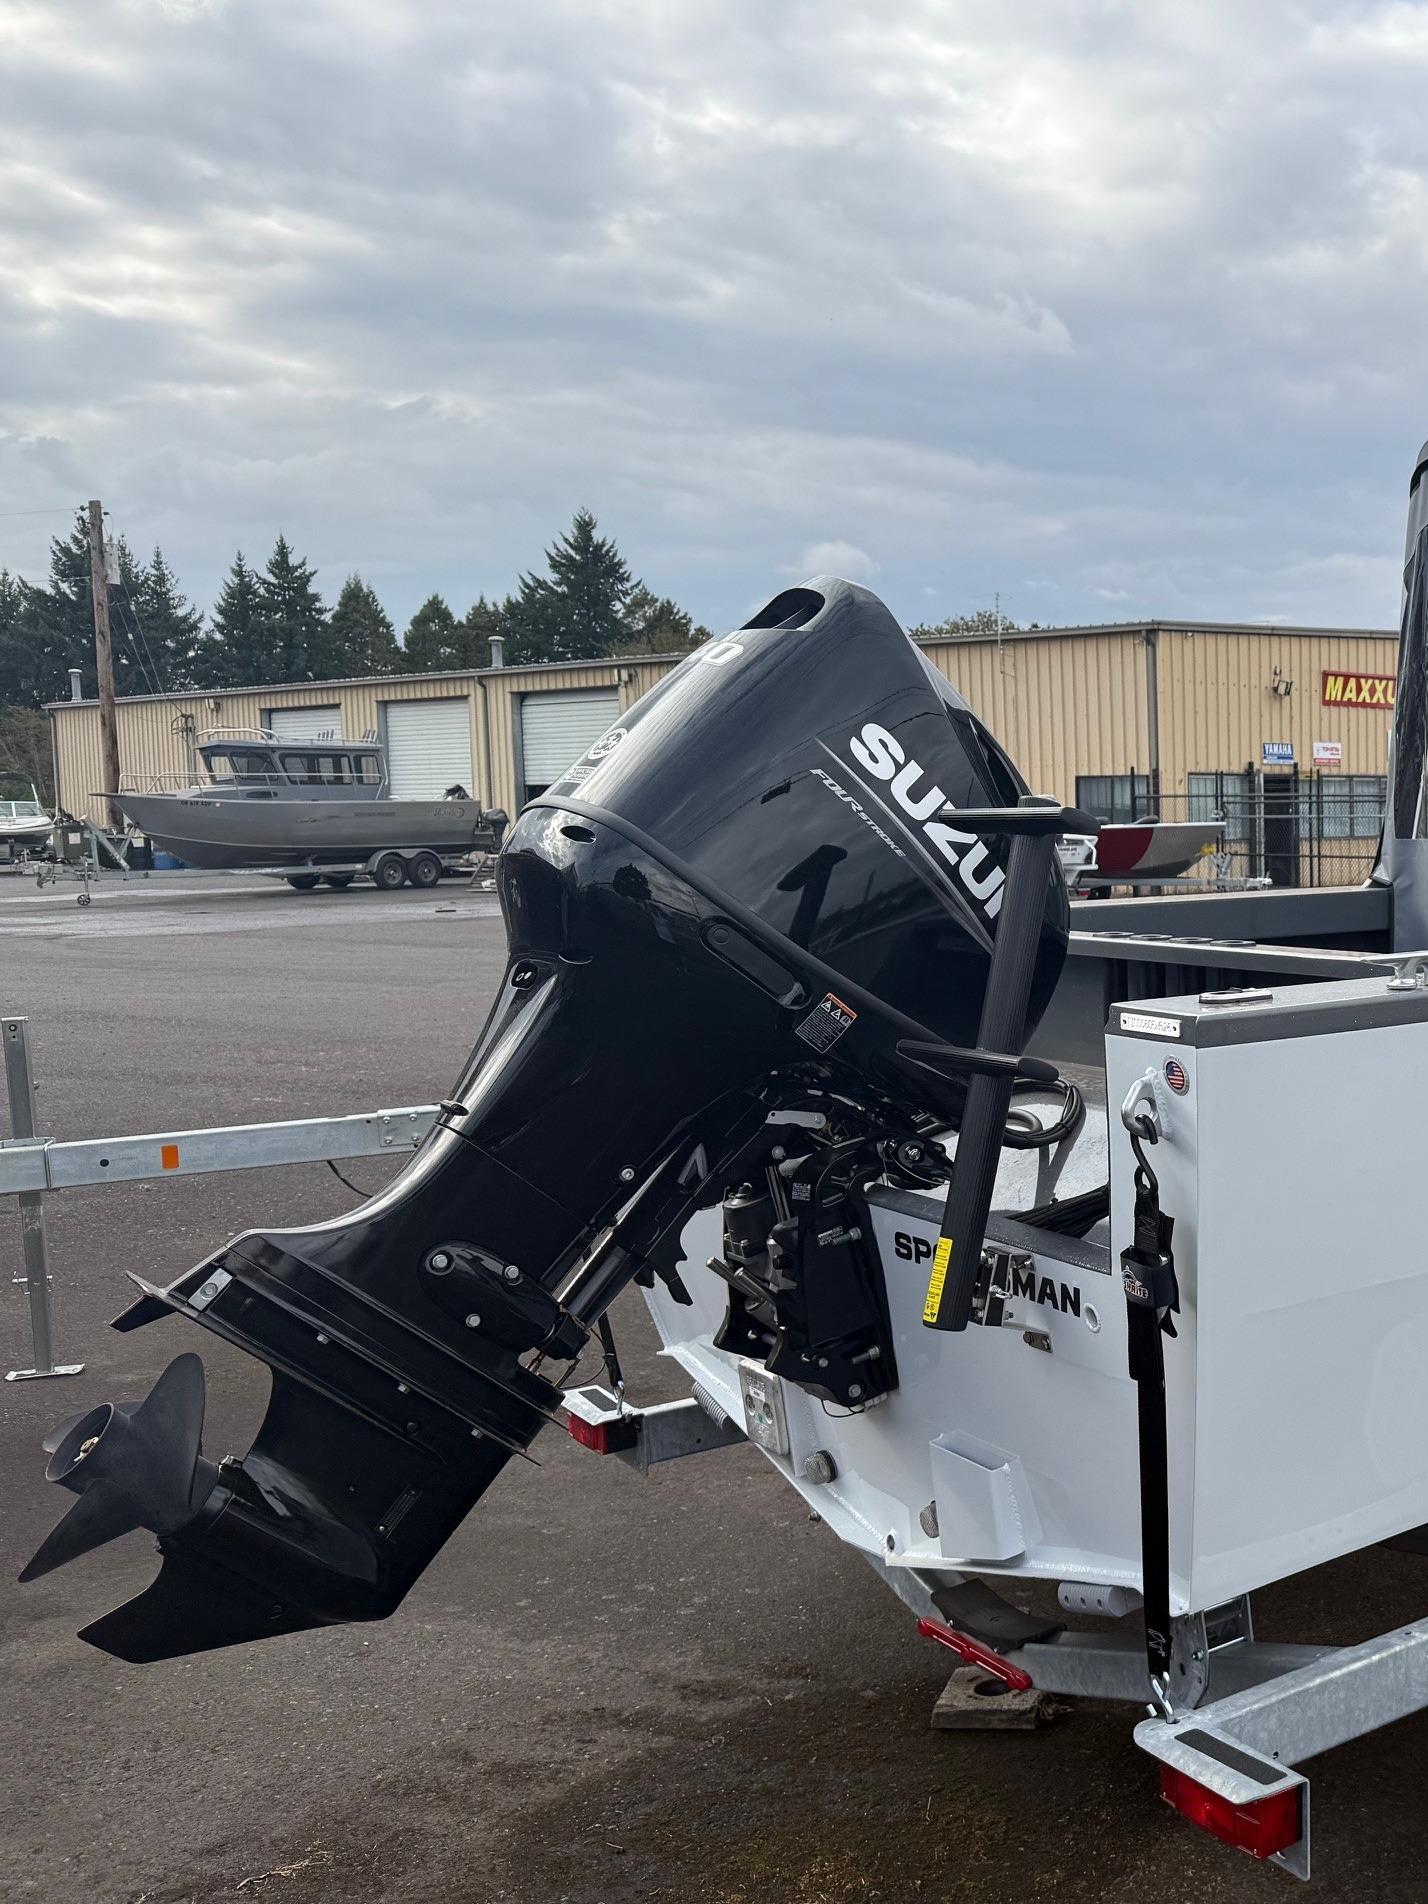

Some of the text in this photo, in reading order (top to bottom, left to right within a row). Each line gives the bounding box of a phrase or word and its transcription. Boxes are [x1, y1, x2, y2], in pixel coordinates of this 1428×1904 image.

[1325, 675, 1395, 704] MAXXU
[1264, 743, 1292, 755] YAMAHA
[850, 723, 1006, 919] SUZU
[894, 1231, 1081, 1318] SPMAN
